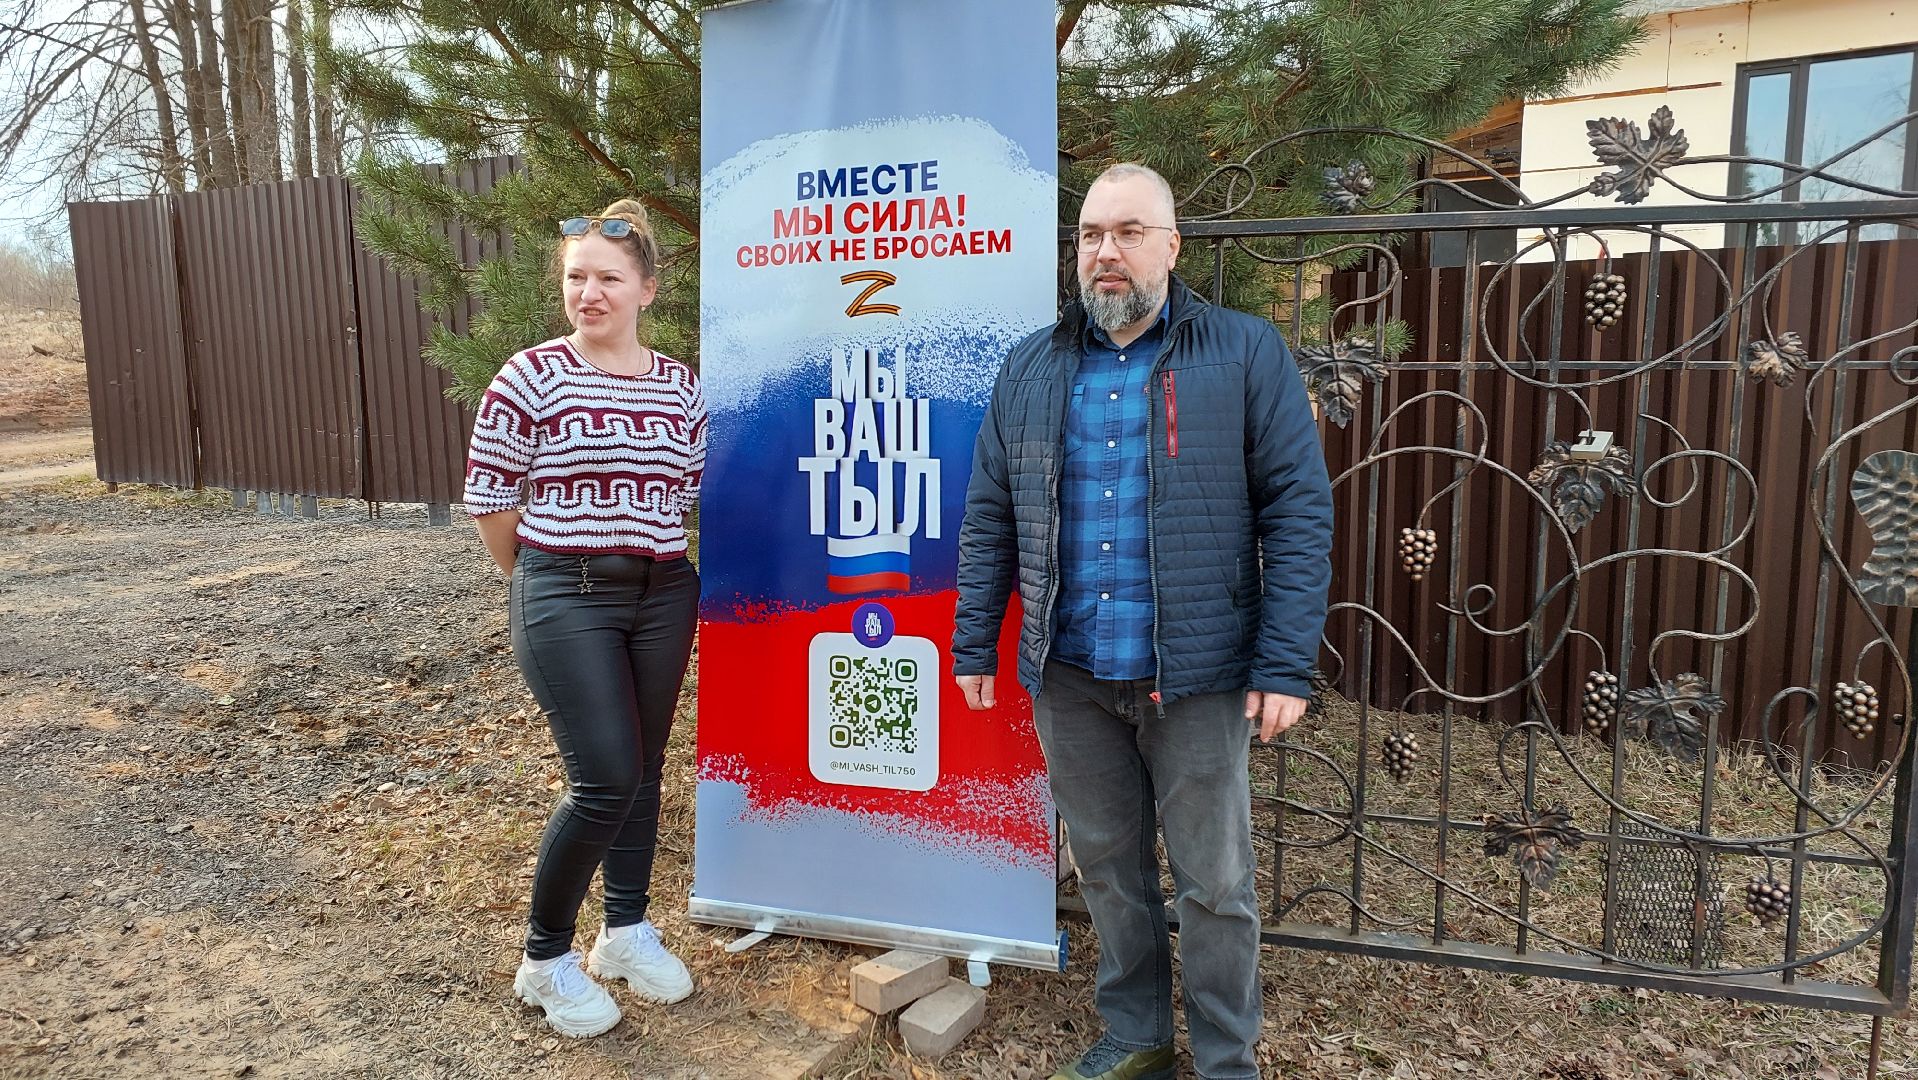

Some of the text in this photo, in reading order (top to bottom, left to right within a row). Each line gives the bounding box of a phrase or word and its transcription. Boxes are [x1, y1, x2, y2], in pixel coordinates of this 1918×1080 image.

[797, 160, 938, 200] ВМЕСТЕ
[773, 194, 966, 239] МЫ СИЛА!
[736, 229, 1012, 268] СВОИХ НЕ БРОСАЕМ
[831, 348, 906, 402] МЫ
[814, 398, 930, 462] ВАШ
[798, 457, 941, 539] ТЫЛ
[830, 761, 916, 776] @MI_VASH_TIL750
